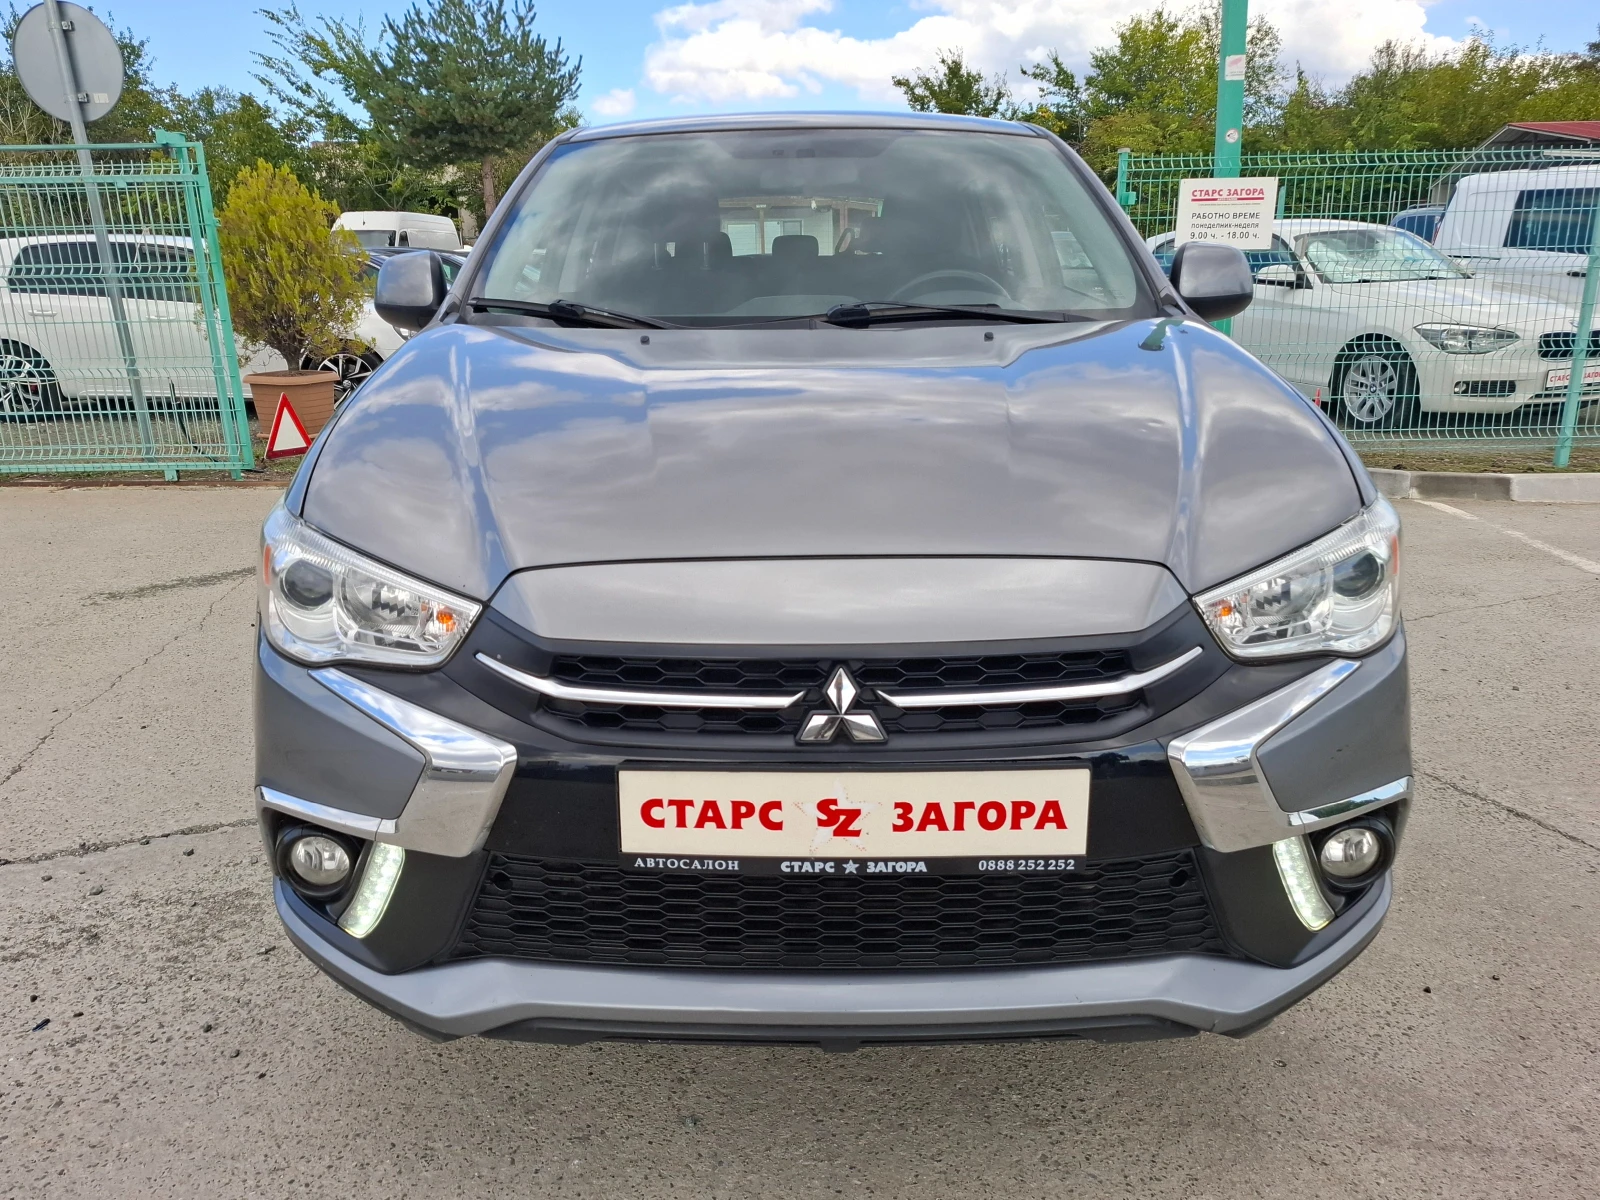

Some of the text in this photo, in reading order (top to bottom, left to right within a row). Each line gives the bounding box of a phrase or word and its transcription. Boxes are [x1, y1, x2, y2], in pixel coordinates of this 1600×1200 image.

[1192, 188, 1264, 197] СТАРС ЗАГОРА
[1191, 222, 1259, 230] понеделник-неделя
[1190, 231, 1208, 240] 9.00
[1227, 231, 1250, 239] 18.00
[640, 797, 1069, 838] СТАРС SZ ЗАГОРА
[633, 857, 1076, 874] АВТОСАЛОН СТАРС ЗАГОРА 0888 252 252
